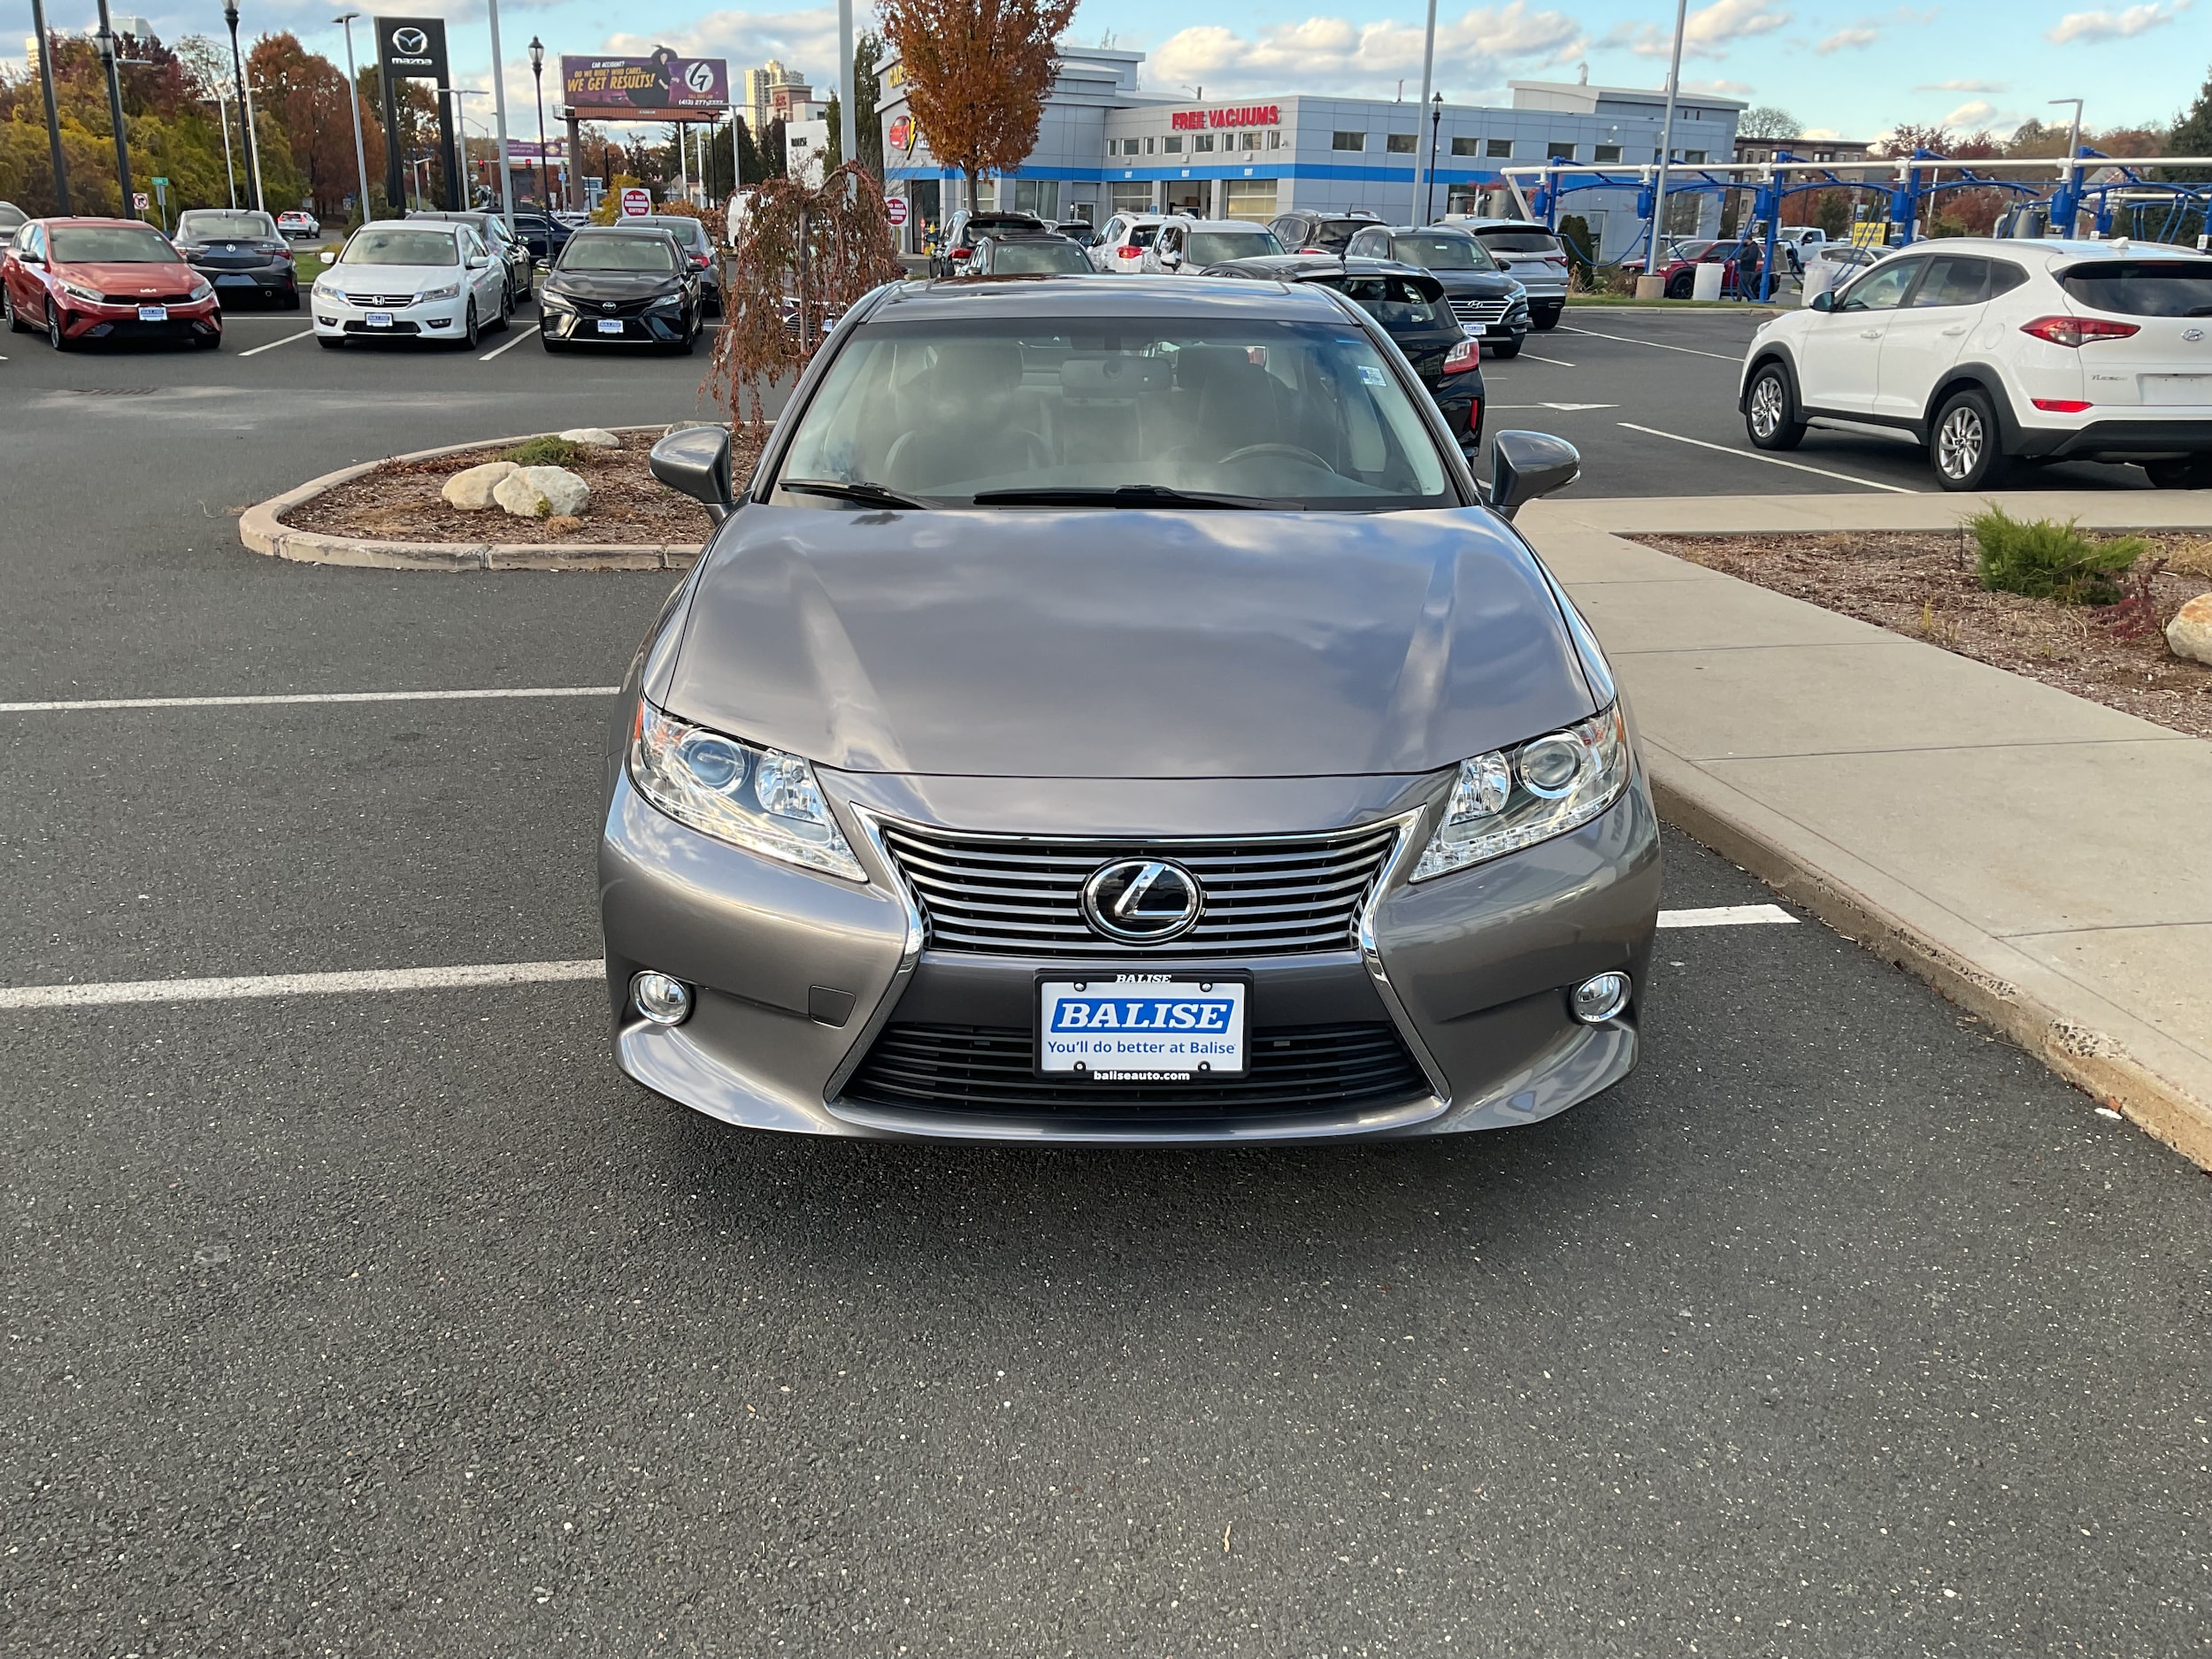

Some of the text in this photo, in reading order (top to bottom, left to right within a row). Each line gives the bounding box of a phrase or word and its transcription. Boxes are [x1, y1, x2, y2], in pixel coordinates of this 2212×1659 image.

[567, 73, 656, 92] WE GET RESULTS!
[1171, 105, 1279, 129] FREE VACUUMS
[1116, 974, 1171, 983] BALISE
[1057, 1002, 1227, 1029] BALISE
[1048, 1041, 1235, 1054] You'll do better at Balise
[1094, 1071, 1190, 1081] baliseauto.com
